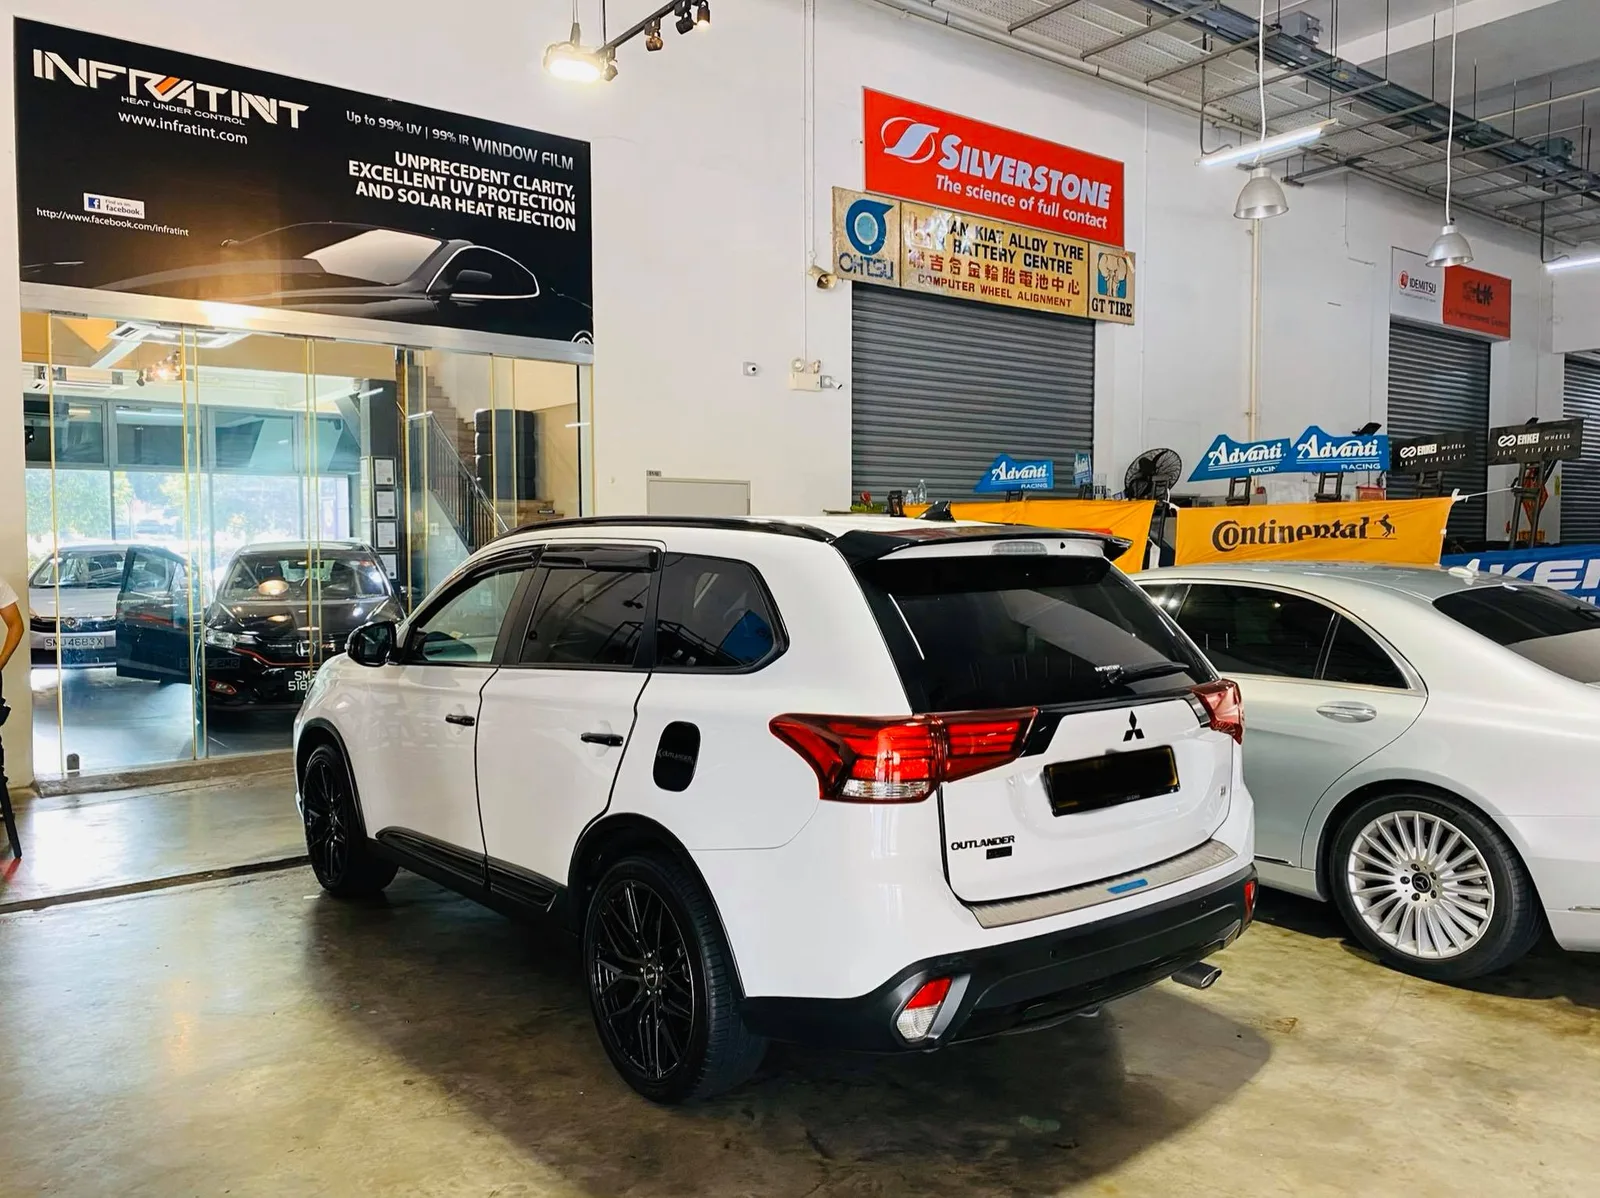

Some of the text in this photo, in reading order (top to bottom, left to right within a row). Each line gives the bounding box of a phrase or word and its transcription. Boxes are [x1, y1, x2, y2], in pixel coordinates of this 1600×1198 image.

[33, 49, 309, 129] INFRATINT
[121, 96, 245, 125] HEAT UNDER CONTROL
[118, 112, 248, 145] www.infratint.com
[346, 110, 361, 124] Up
[364, 114, 376, 127] to
[378, 117, 404, 133] 99%
[406, 123, 421, 136] UV
[432, 129, 456, 143] 99%
[459, 134, 469, 146] IR
[472, 136, 538, 163] WINDOW
[541, 151, 574, 171] FILM
[394, 151, 576, 200] UNPRECEDENT CLARITY,
[938, 133, 1112, 210] SILVERSTONE
[348, 160, 576, 215] EXCELLENT UV PROTECTION
[936, 174, 1107, 231] The science of full contact
[355, 181, 576, 232] AND SOLAR HEAT REJECTION
[36, 207, 189, 237] http://www.facebook.com/infratint
[948, 219, 1084, 261] AN KIAT ALLOY TYRE
[838, 252, 894, 280] OHTSU
[953, 238, 1073, 275] BATTERY CENTRE
[918, 274, 1072, 308] COMPUTER WHEEL ALIGNMENT
[1409, 278, 1437, 294] IDEMITSU
[1091, 298, 1132, 318] GT TIRE
[1208, 442, 1282, 466] Advanti
[1297, 433, 1378, 459] Advanti
[991, 461, 1047, 480] Advanti
[1248, 465, 1278, 474] RACIN
[1341, 462, 1381, 470] RACING
[1212, 516, 1370, 552] Continental
[288, 680, 309, 691] 518
[294, 670, 317, 681] SM
[951, 835, 1015, 850] OUTLANDER
